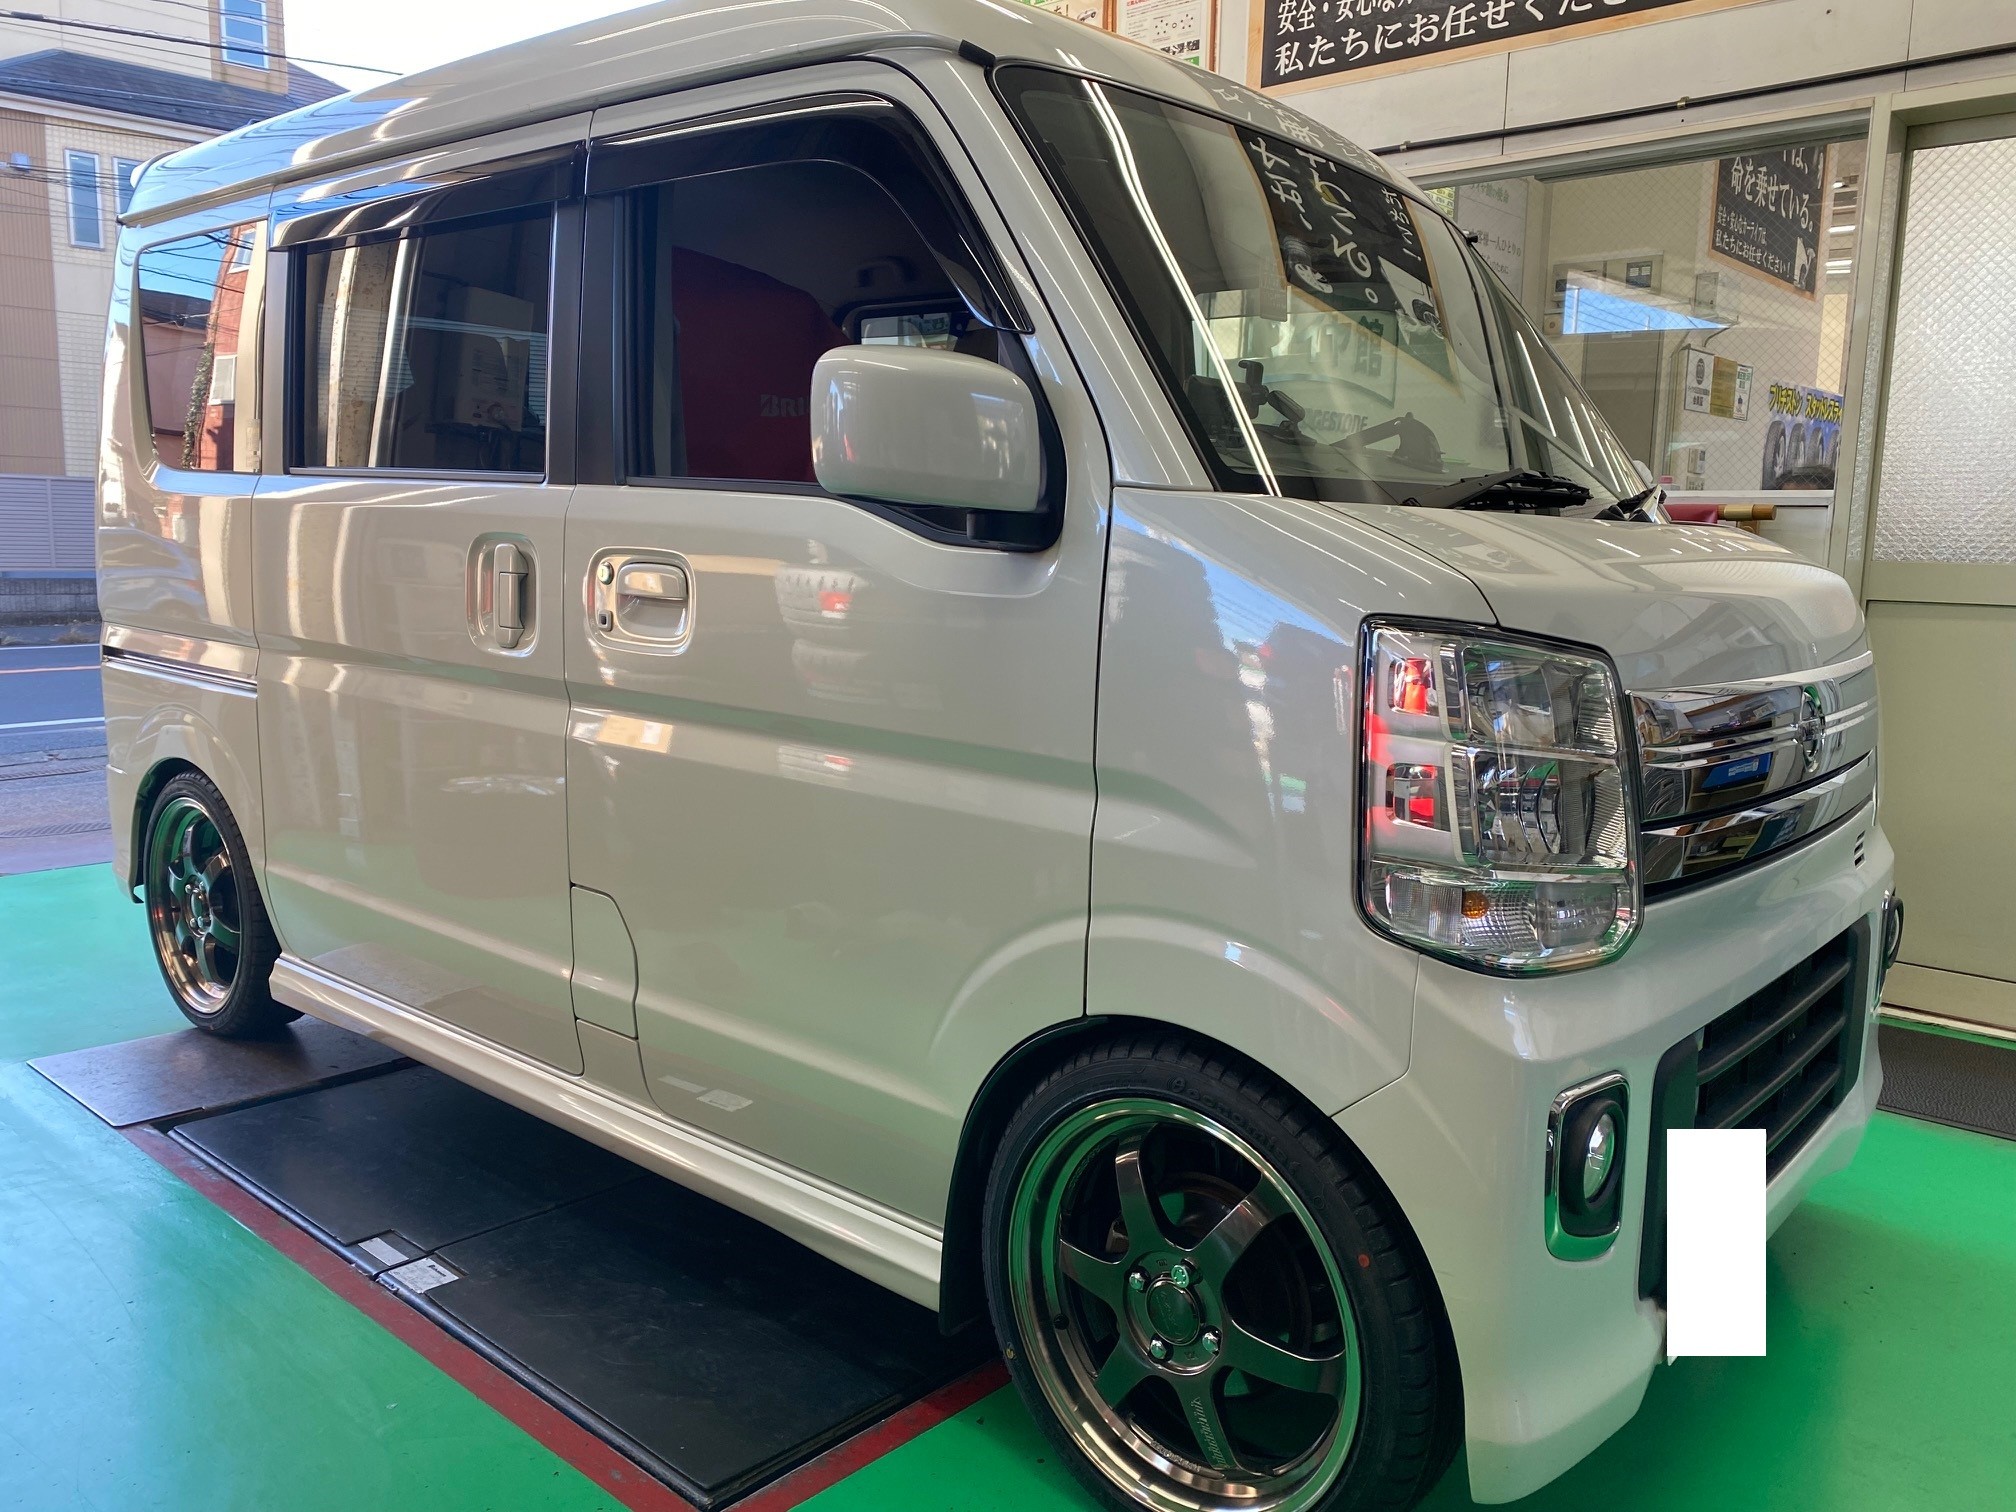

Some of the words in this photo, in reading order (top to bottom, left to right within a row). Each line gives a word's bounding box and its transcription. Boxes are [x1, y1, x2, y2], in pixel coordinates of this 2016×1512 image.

[1274, 0, 1626, 76] 私たちにお任せく
[1277, 0, 1412, 35] 安全・安心
[1731, 156, 1814, 233] 命を乗せている。
[760, 394, 808, 417] BRI
